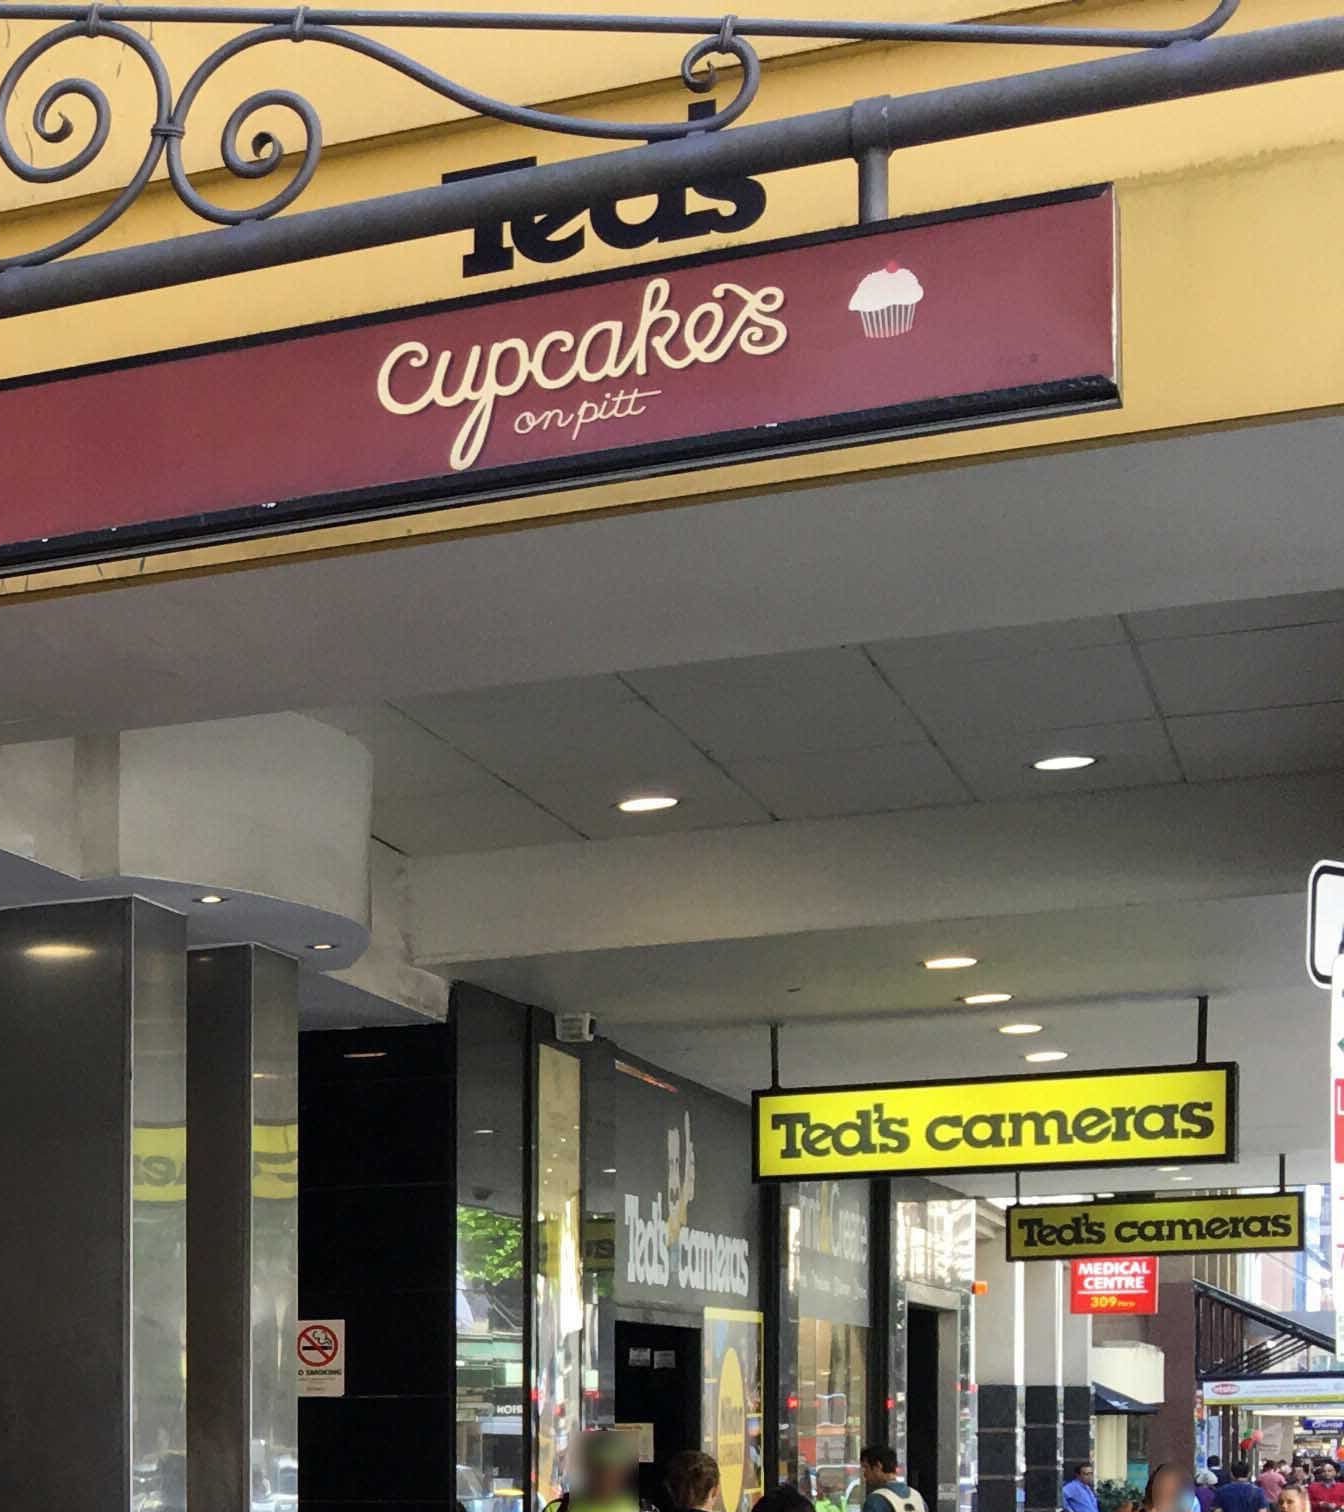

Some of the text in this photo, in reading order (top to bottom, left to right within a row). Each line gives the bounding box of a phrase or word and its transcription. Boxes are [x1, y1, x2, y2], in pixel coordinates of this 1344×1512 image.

[513, 389, 662, 440] on pitt
[771, 1099, 1215, 1160] Ted's cameras
[624, 1191, 670, 1287] Ted's
[678, 1224, 749, 1298] cameras
[1018, 1210, 1292, 1247] Ted's cameras
[1077, 1260, 1152, 1275] MEDICAL
[1083, 1275, 1145, 1290] CENTRE
[1090, 1296, 1117, 1308] 309
